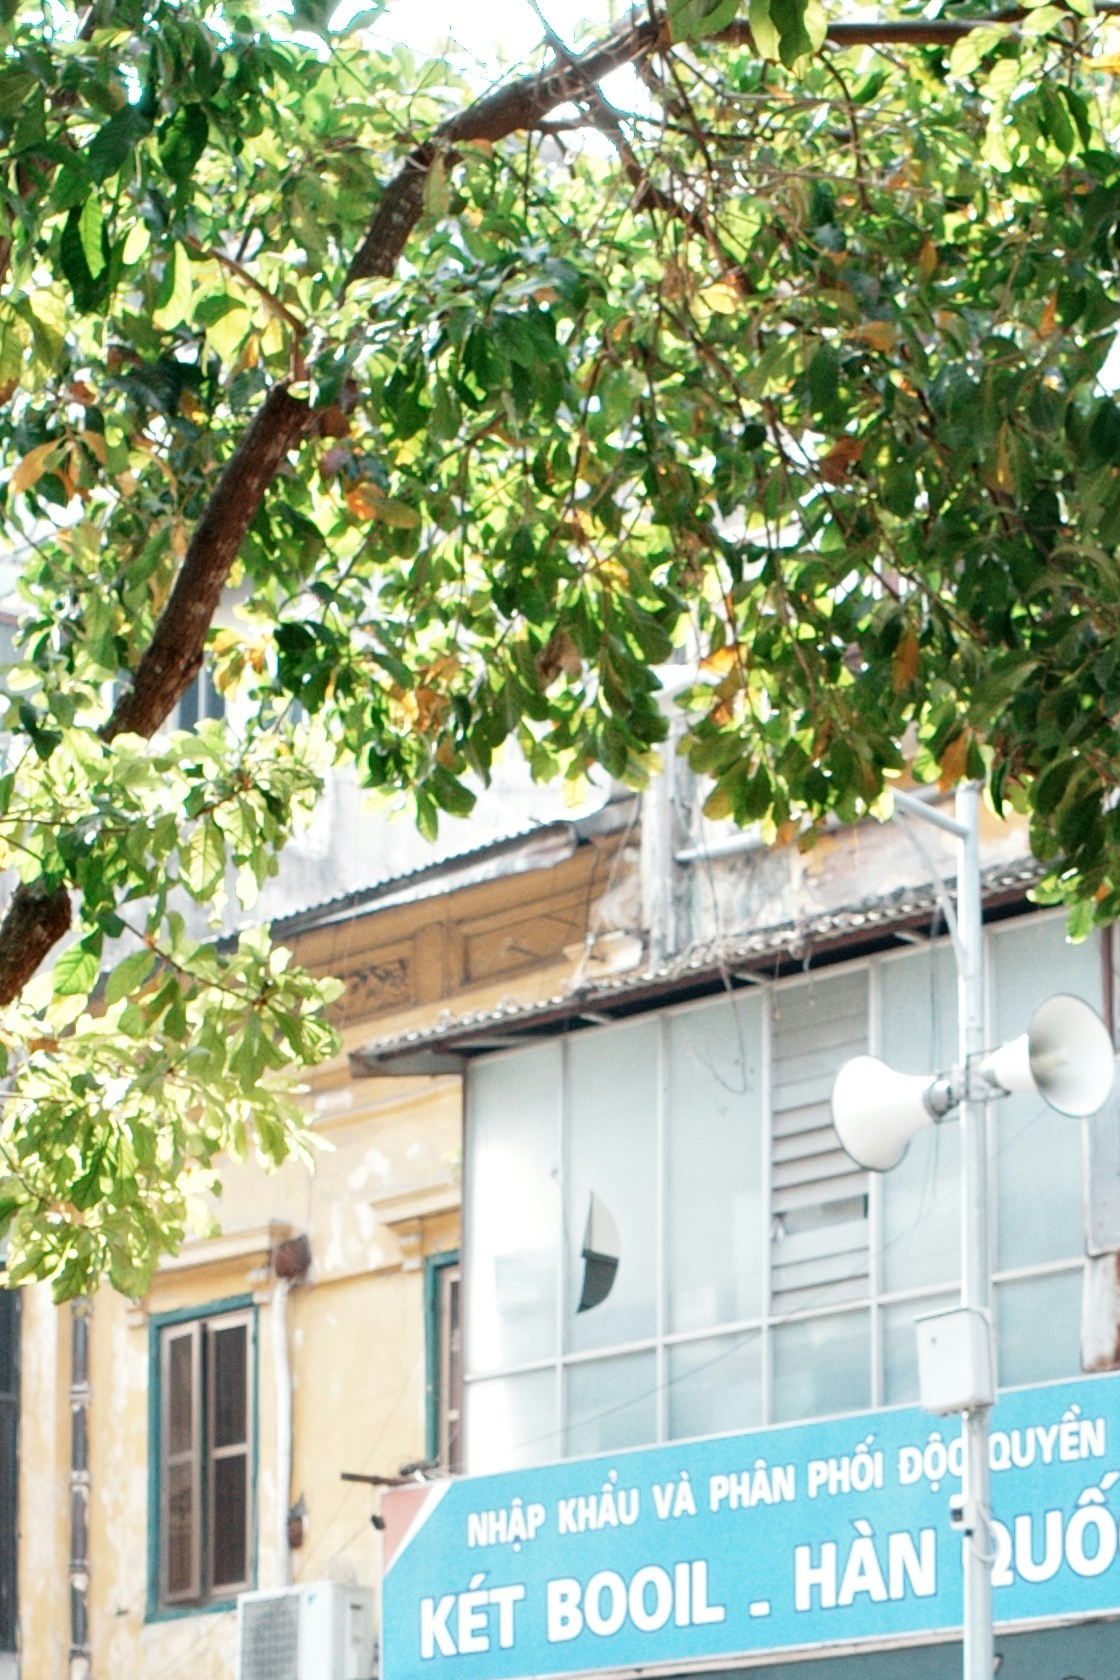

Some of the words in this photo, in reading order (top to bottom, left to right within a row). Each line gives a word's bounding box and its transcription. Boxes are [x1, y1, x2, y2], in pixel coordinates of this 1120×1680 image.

[466, 1496, 546, 1553] NHẬP
[557, 1468, 640, 1535] KHẨU
[651, 1470, 698, 1521] VÀ
[709, 1458, 796, 1512] PHÂN
[807, 1434, 884, 1499] PHỐI
[988, 1404, 1106, 1471] QUYỀN
[419, 1570, 526, 1660] KÉT
[546, 1558, 726, 1643] BOOIL
[794, 1518, 937, 1613] HÀN
